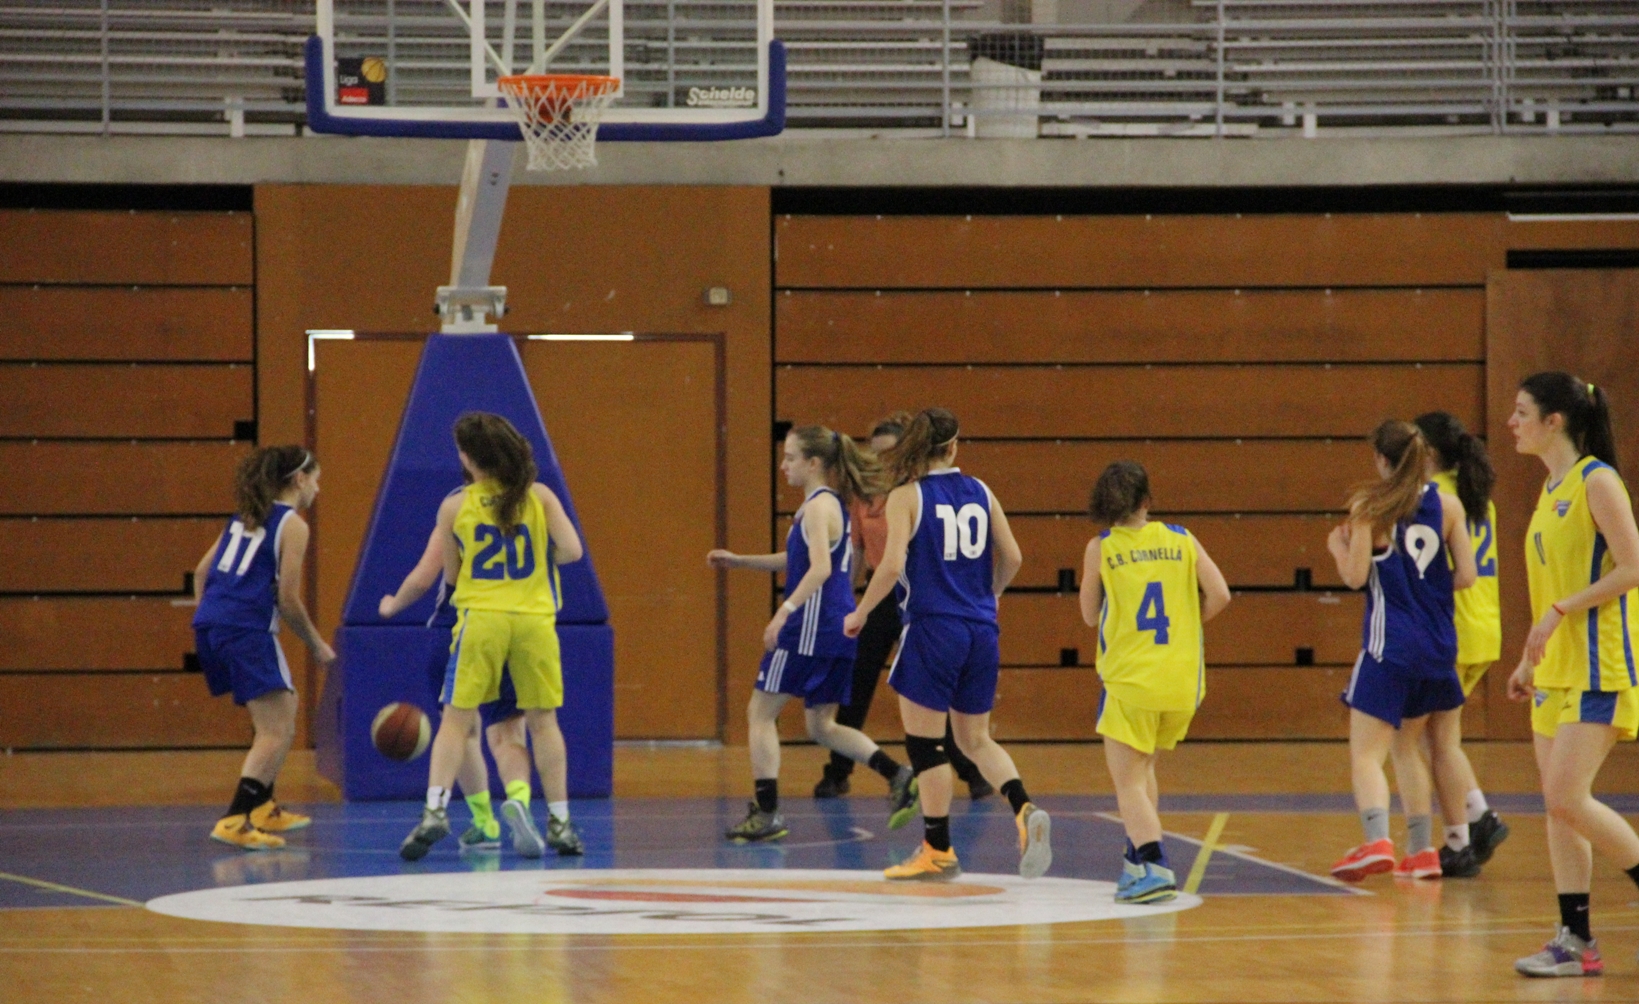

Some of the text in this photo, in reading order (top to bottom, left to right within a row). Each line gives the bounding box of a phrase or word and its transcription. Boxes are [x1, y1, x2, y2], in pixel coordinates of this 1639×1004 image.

[217, 520, 267, 576] 17
[472, 523, 535, 580] 20
[935, 503, 988, 561] 10
[1405, 523, 1440, 579] 9
[1136, 581, 1170, 645] 4
